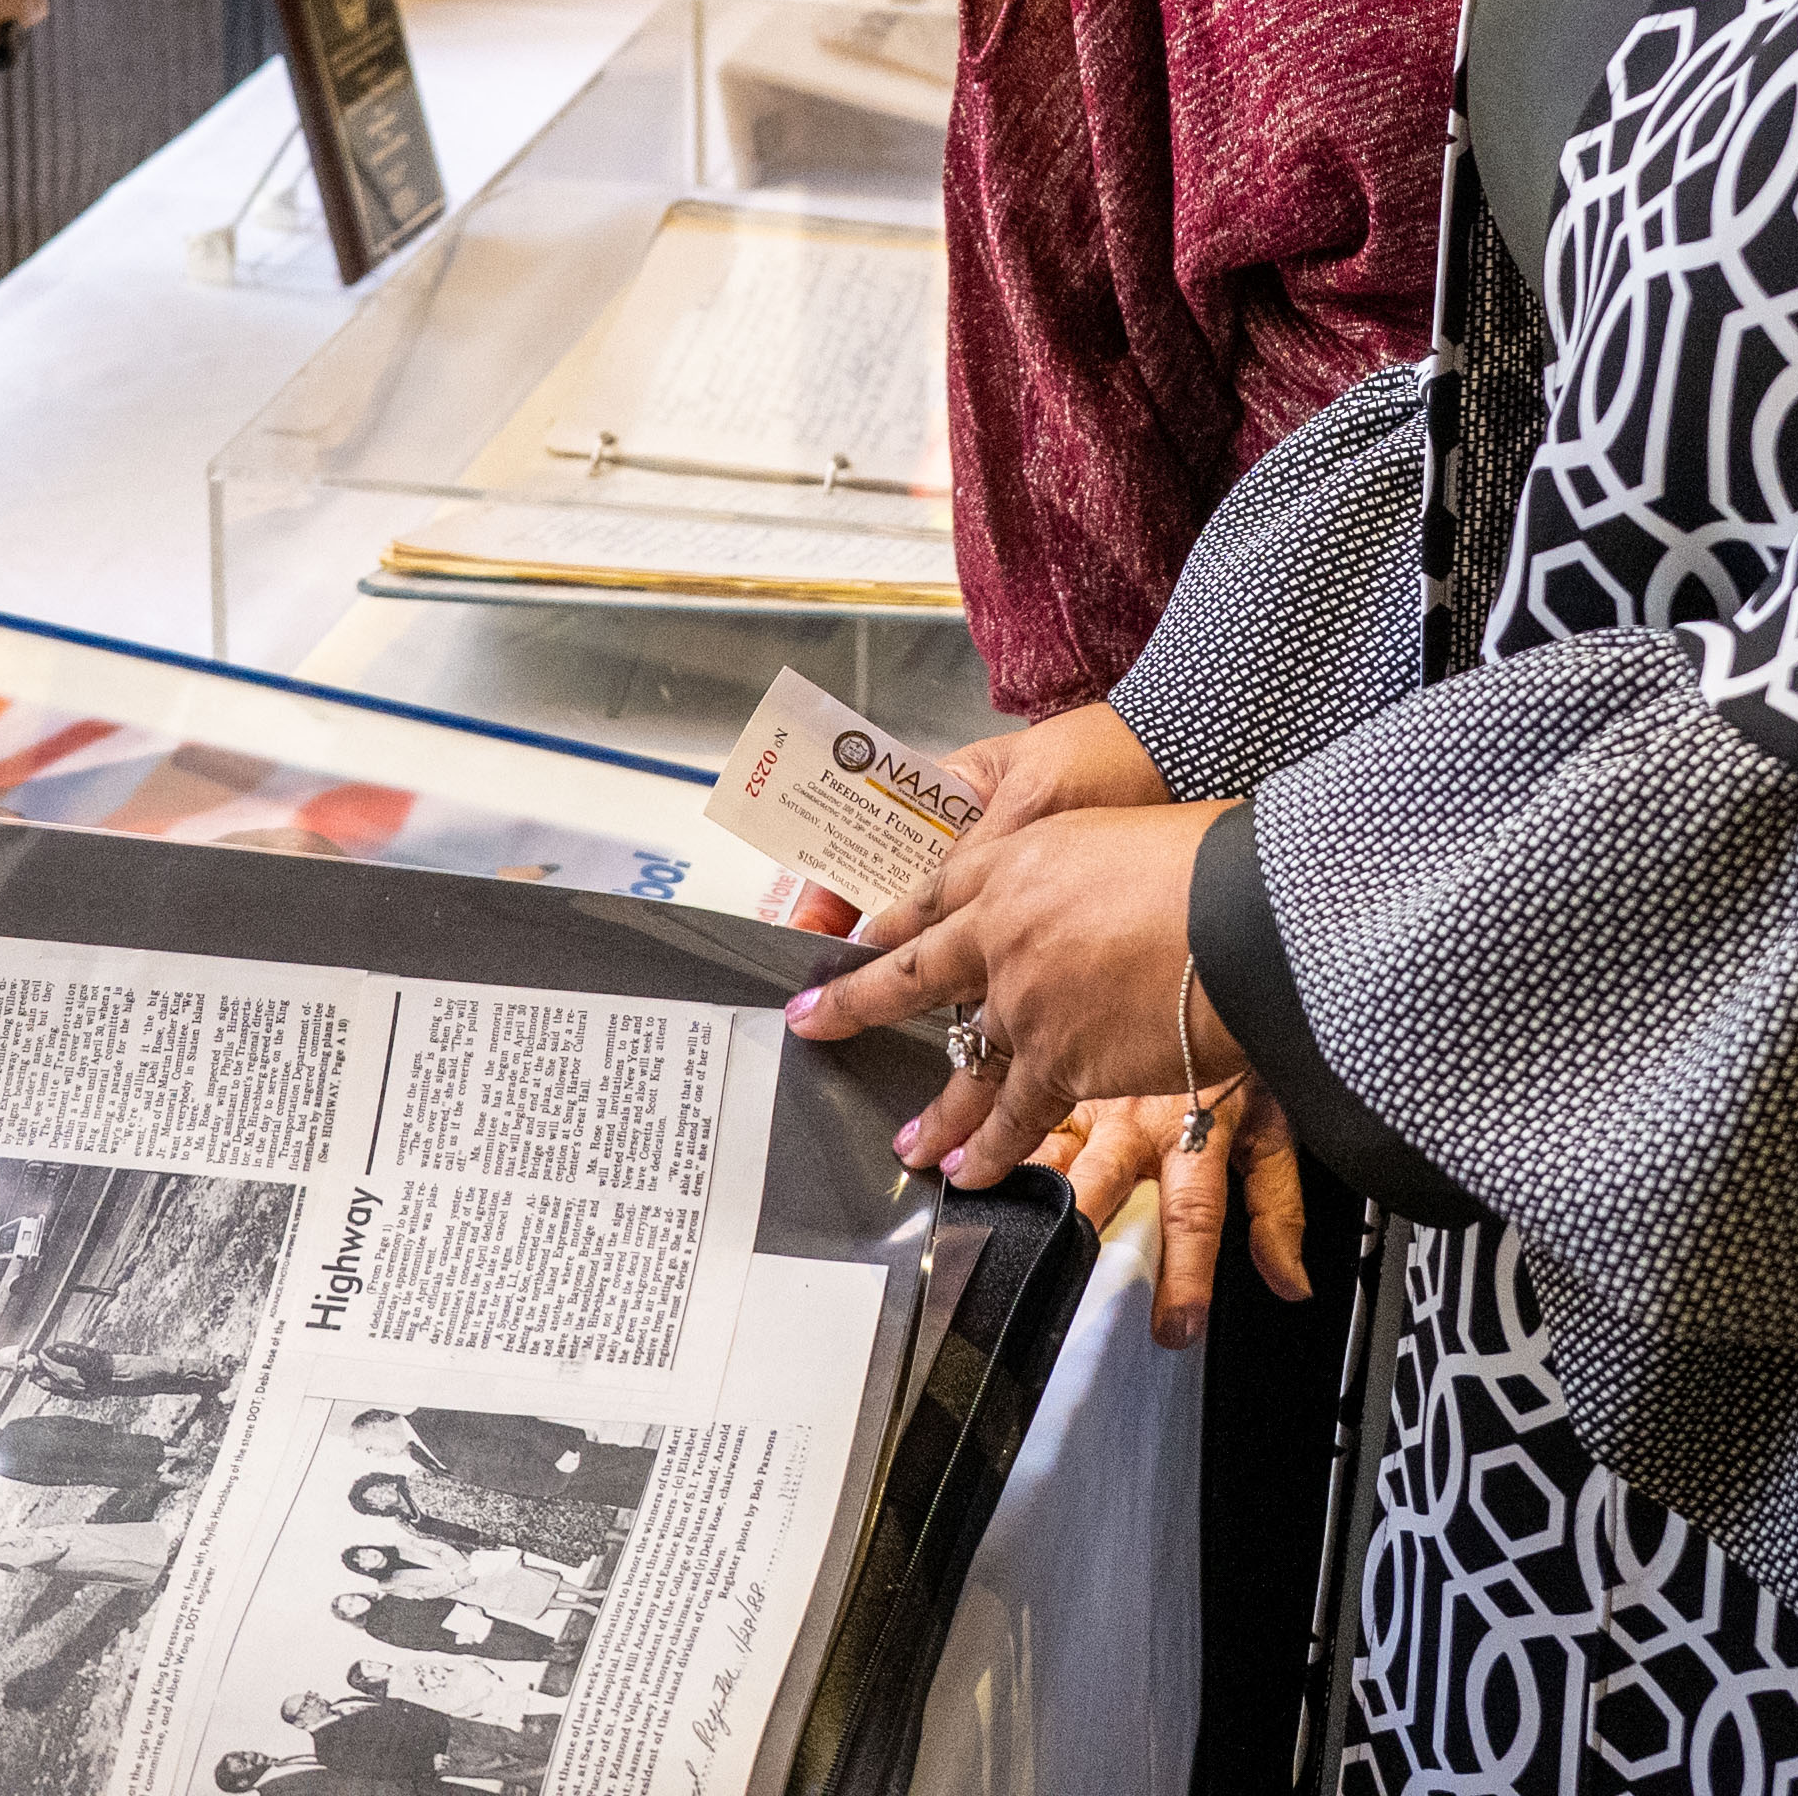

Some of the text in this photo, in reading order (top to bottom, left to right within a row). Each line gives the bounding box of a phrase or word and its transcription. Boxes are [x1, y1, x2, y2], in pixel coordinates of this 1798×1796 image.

[745, 750, 778, 798] 0252
[875, 753, 982, 825] NAACP
[820, 769, 880, 817] FREEDOM
[885, 811, 923, 843] FUND
[778, 792, 820, 828] SATURDAY,
[823, 822, 868, 857] NOVEMBER
[887, 863, 910, 883] 2025
[612, 852, 691, 901] oo!
[317, 1018, 349, 1162] (See HIGHWAY, Page A 10)
[397, 1204, 409, 1215] be
[401, 1180, 414, 1200] held
[396, 1218, 405, 1228] to
[306, 1187, 382, 1330] Highway
[366, 1224, 393, 1294] (From Page 1)
[385, 1232, 404, 1278] ceremony
[370, 1281, 390, 1329] dedication
[717, 1429, 777, 1599] Register photo by Bob Parsons
